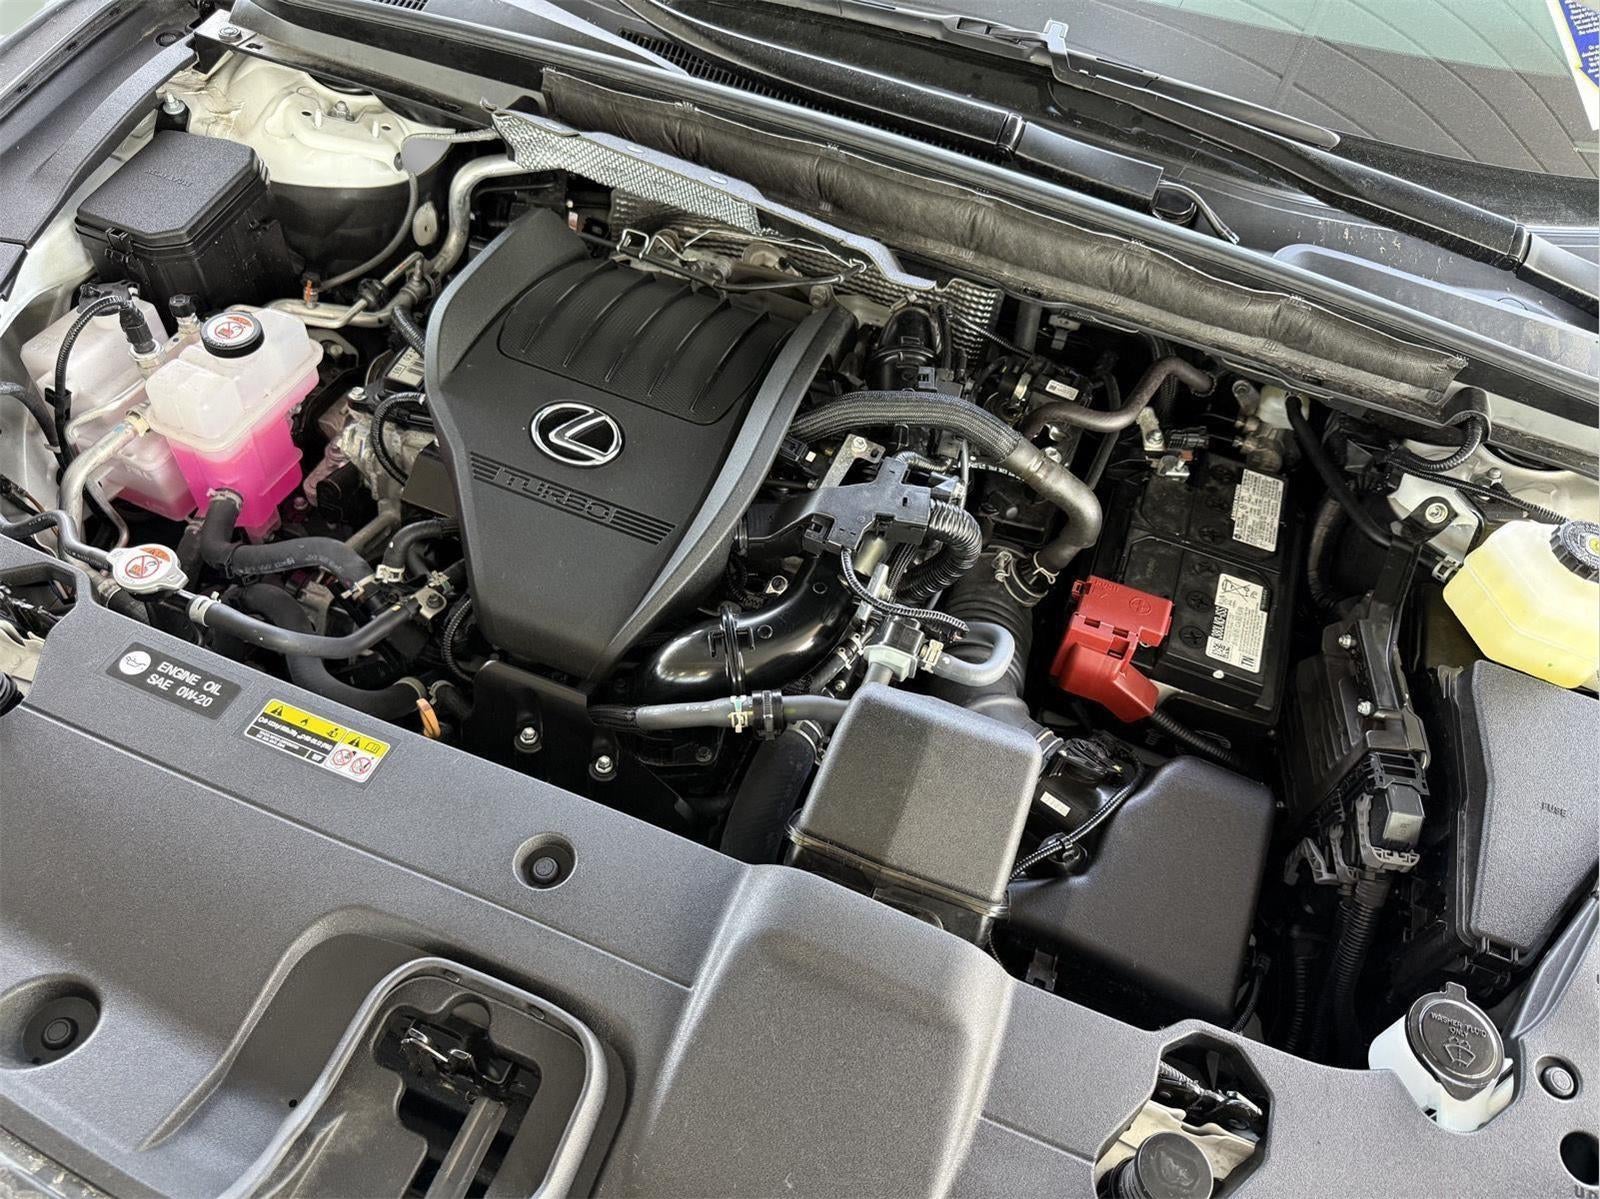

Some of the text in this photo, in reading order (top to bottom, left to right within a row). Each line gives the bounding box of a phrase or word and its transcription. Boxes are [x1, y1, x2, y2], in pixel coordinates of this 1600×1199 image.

[500, 469, 613, 521] TURBO
[146, 673, 214, 707] SAE 0W-20
[157, 661, 222, 696] ENGINE OIL
[1541, 801, 1567, 818] FUSE
[1430, 1011, 1487, 1038] WASHER FLUID
[1449, 1026, 1469, 1038] ONLY
